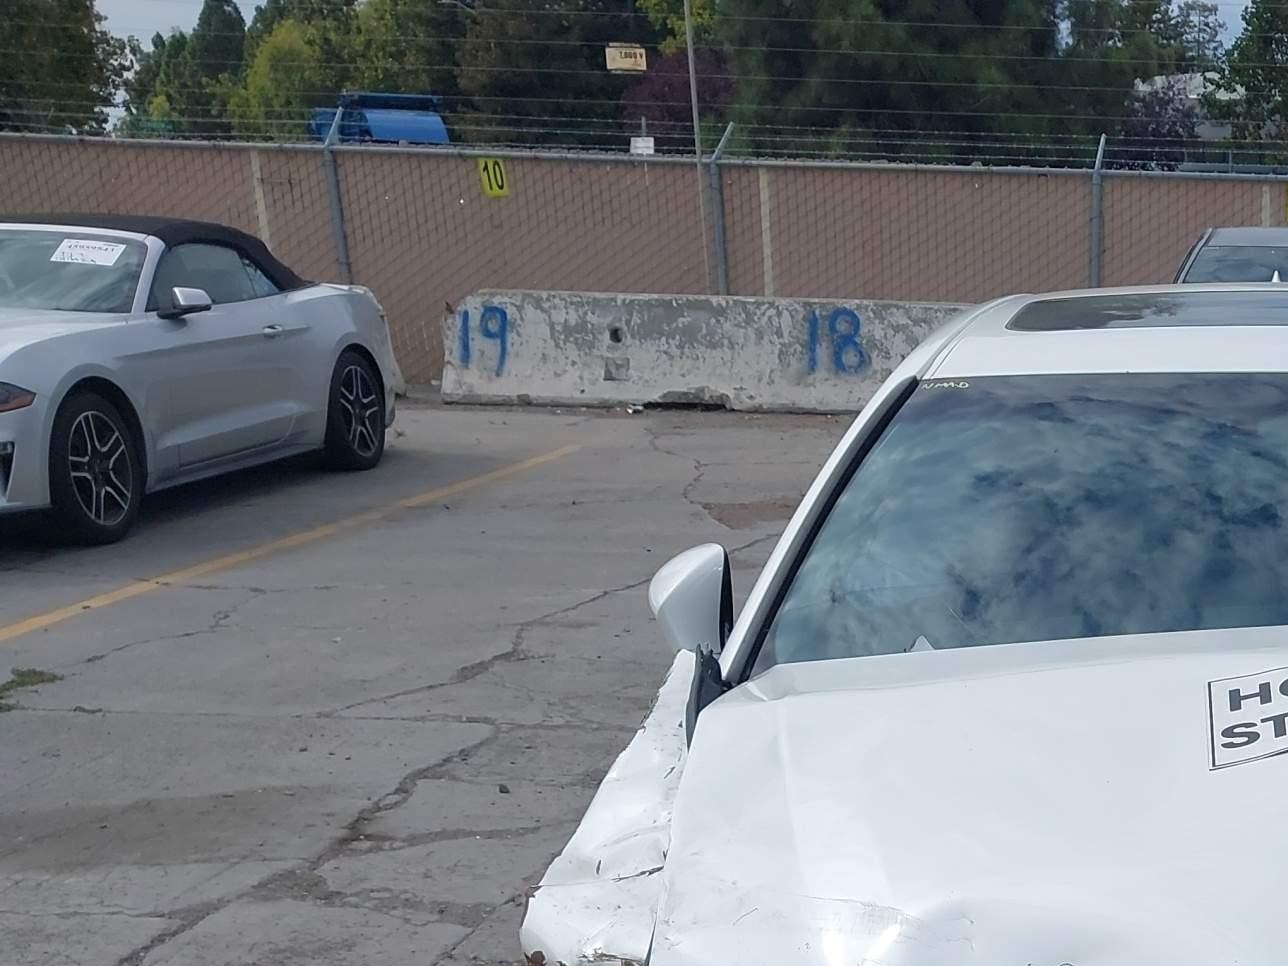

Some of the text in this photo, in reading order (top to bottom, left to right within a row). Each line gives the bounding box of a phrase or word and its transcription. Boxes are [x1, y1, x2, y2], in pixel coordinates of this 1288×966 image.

[483, 160, 504, 190] 10
[460, 306, 508, 377] 19
[807, 306, 869, 375] 18
